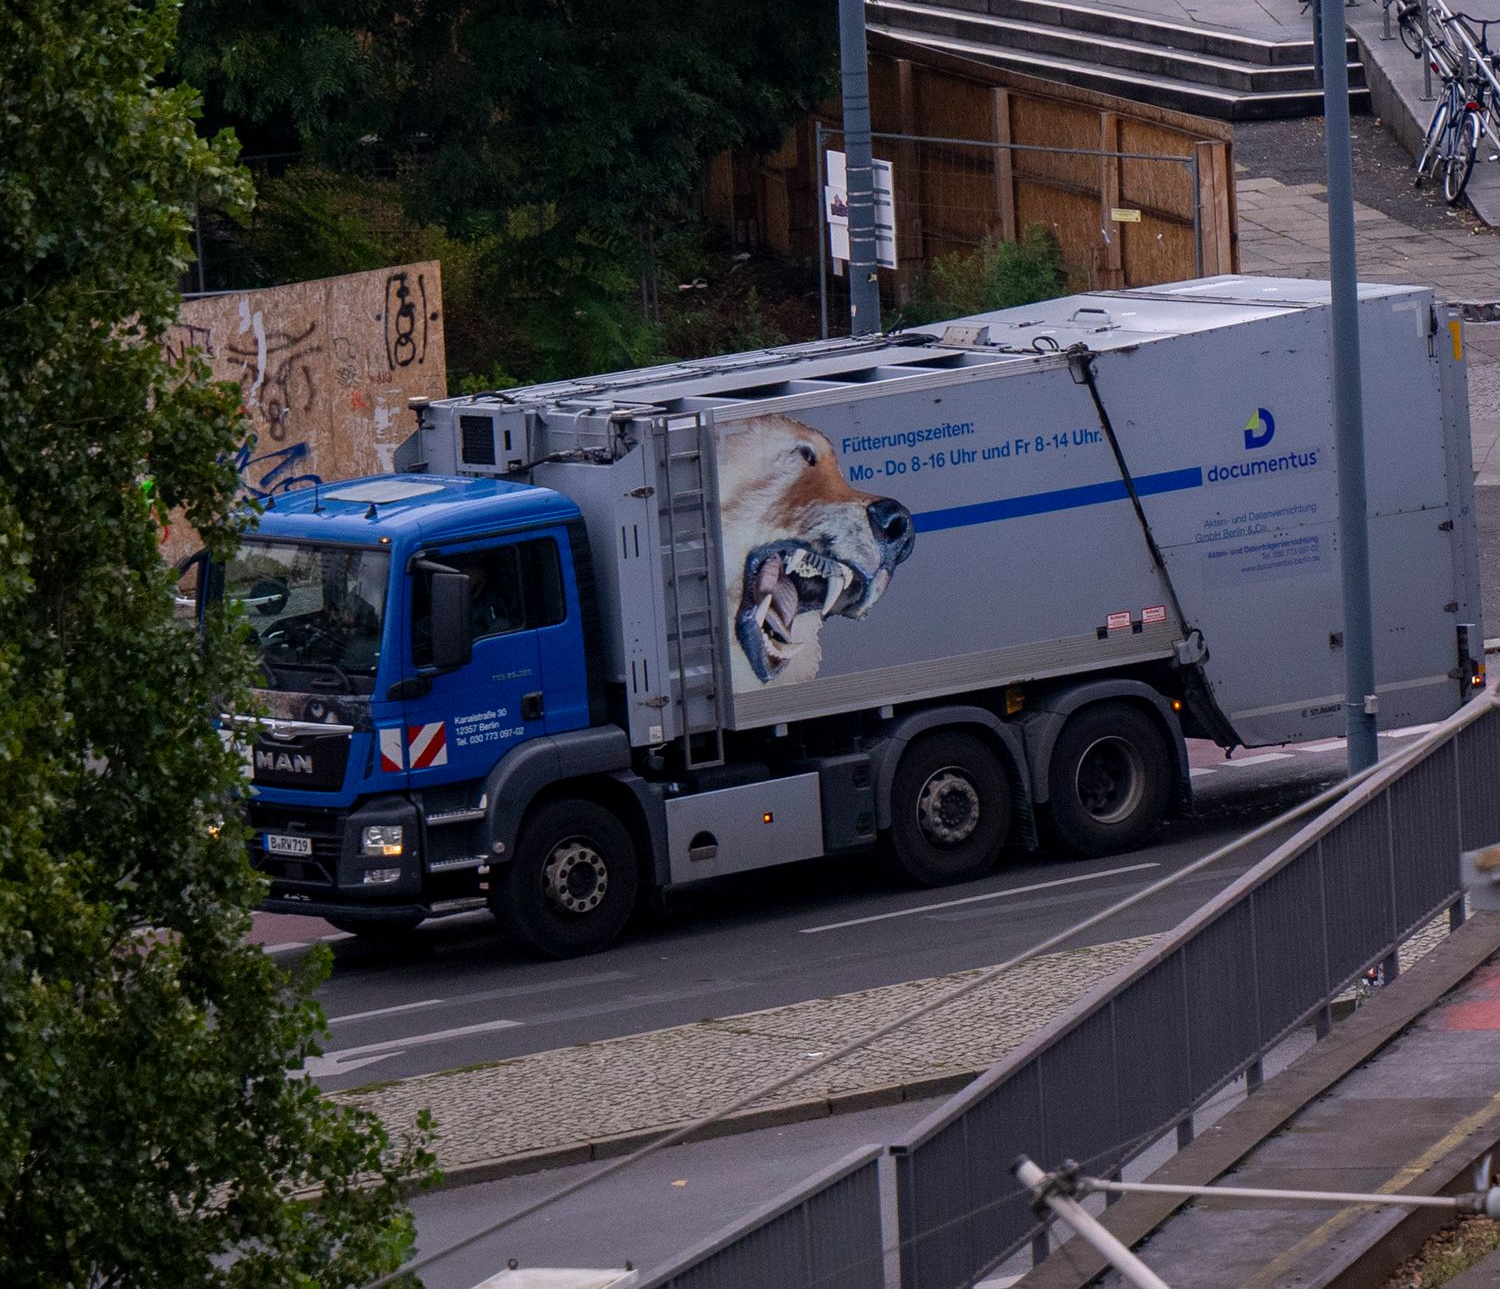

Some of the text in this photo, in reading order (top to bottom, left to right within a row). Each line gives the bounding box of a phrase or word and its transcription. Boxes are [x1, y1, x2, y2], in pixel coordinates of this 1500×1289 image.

[842, 422, 975, 454] Fütterungszeiten:
[850, 465, 874, 482] Mo
[885, 460, 906, 477] Do
[950, 448, 978, 466] Uhr
[982, 441, 1011, 461] und
[1015, 439, 1031, 456] Fr
[1207, 452, 1317, 483] documentus
[485, 731, 499, 741] 773
[256, 750, 313, 774] MAN
